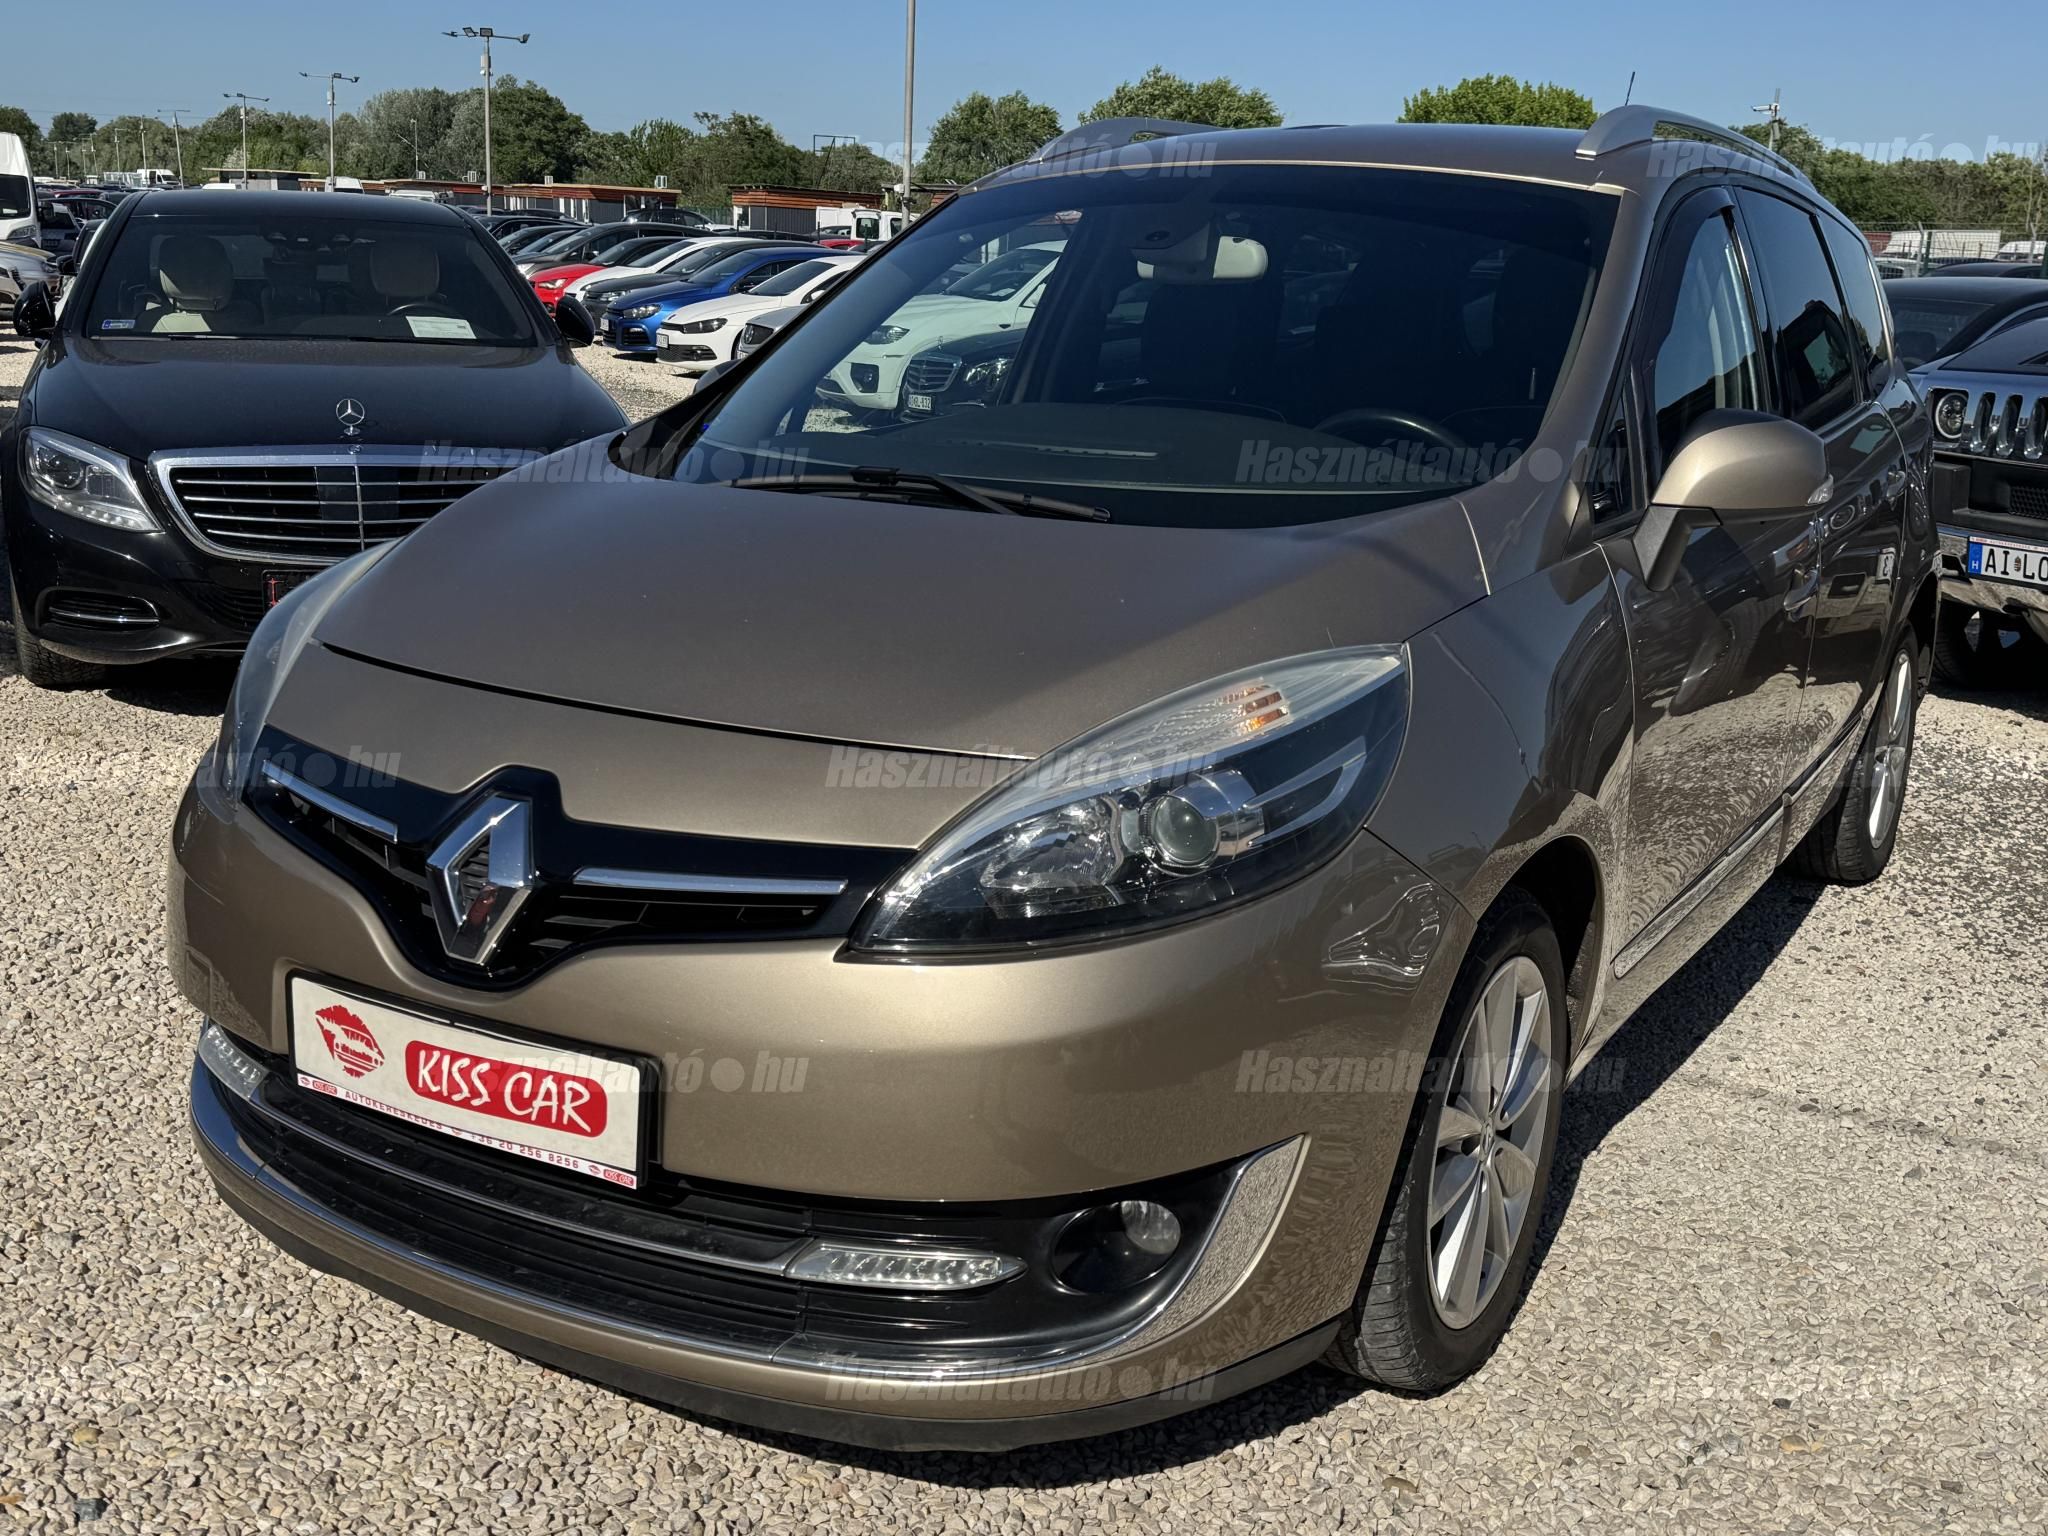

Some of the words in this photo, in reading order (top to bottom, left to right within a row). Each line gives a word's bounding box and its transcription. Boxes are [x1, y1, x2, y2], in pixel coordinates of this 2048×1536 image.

[417, 1049, 492, 1107] KISS
[504, 1071, 592, 1133] CAR
[499, 1141, 514, 1151] 20
[519, 1145, 542, 1159] 256
[548, 1153, 580, 1169] 8256
